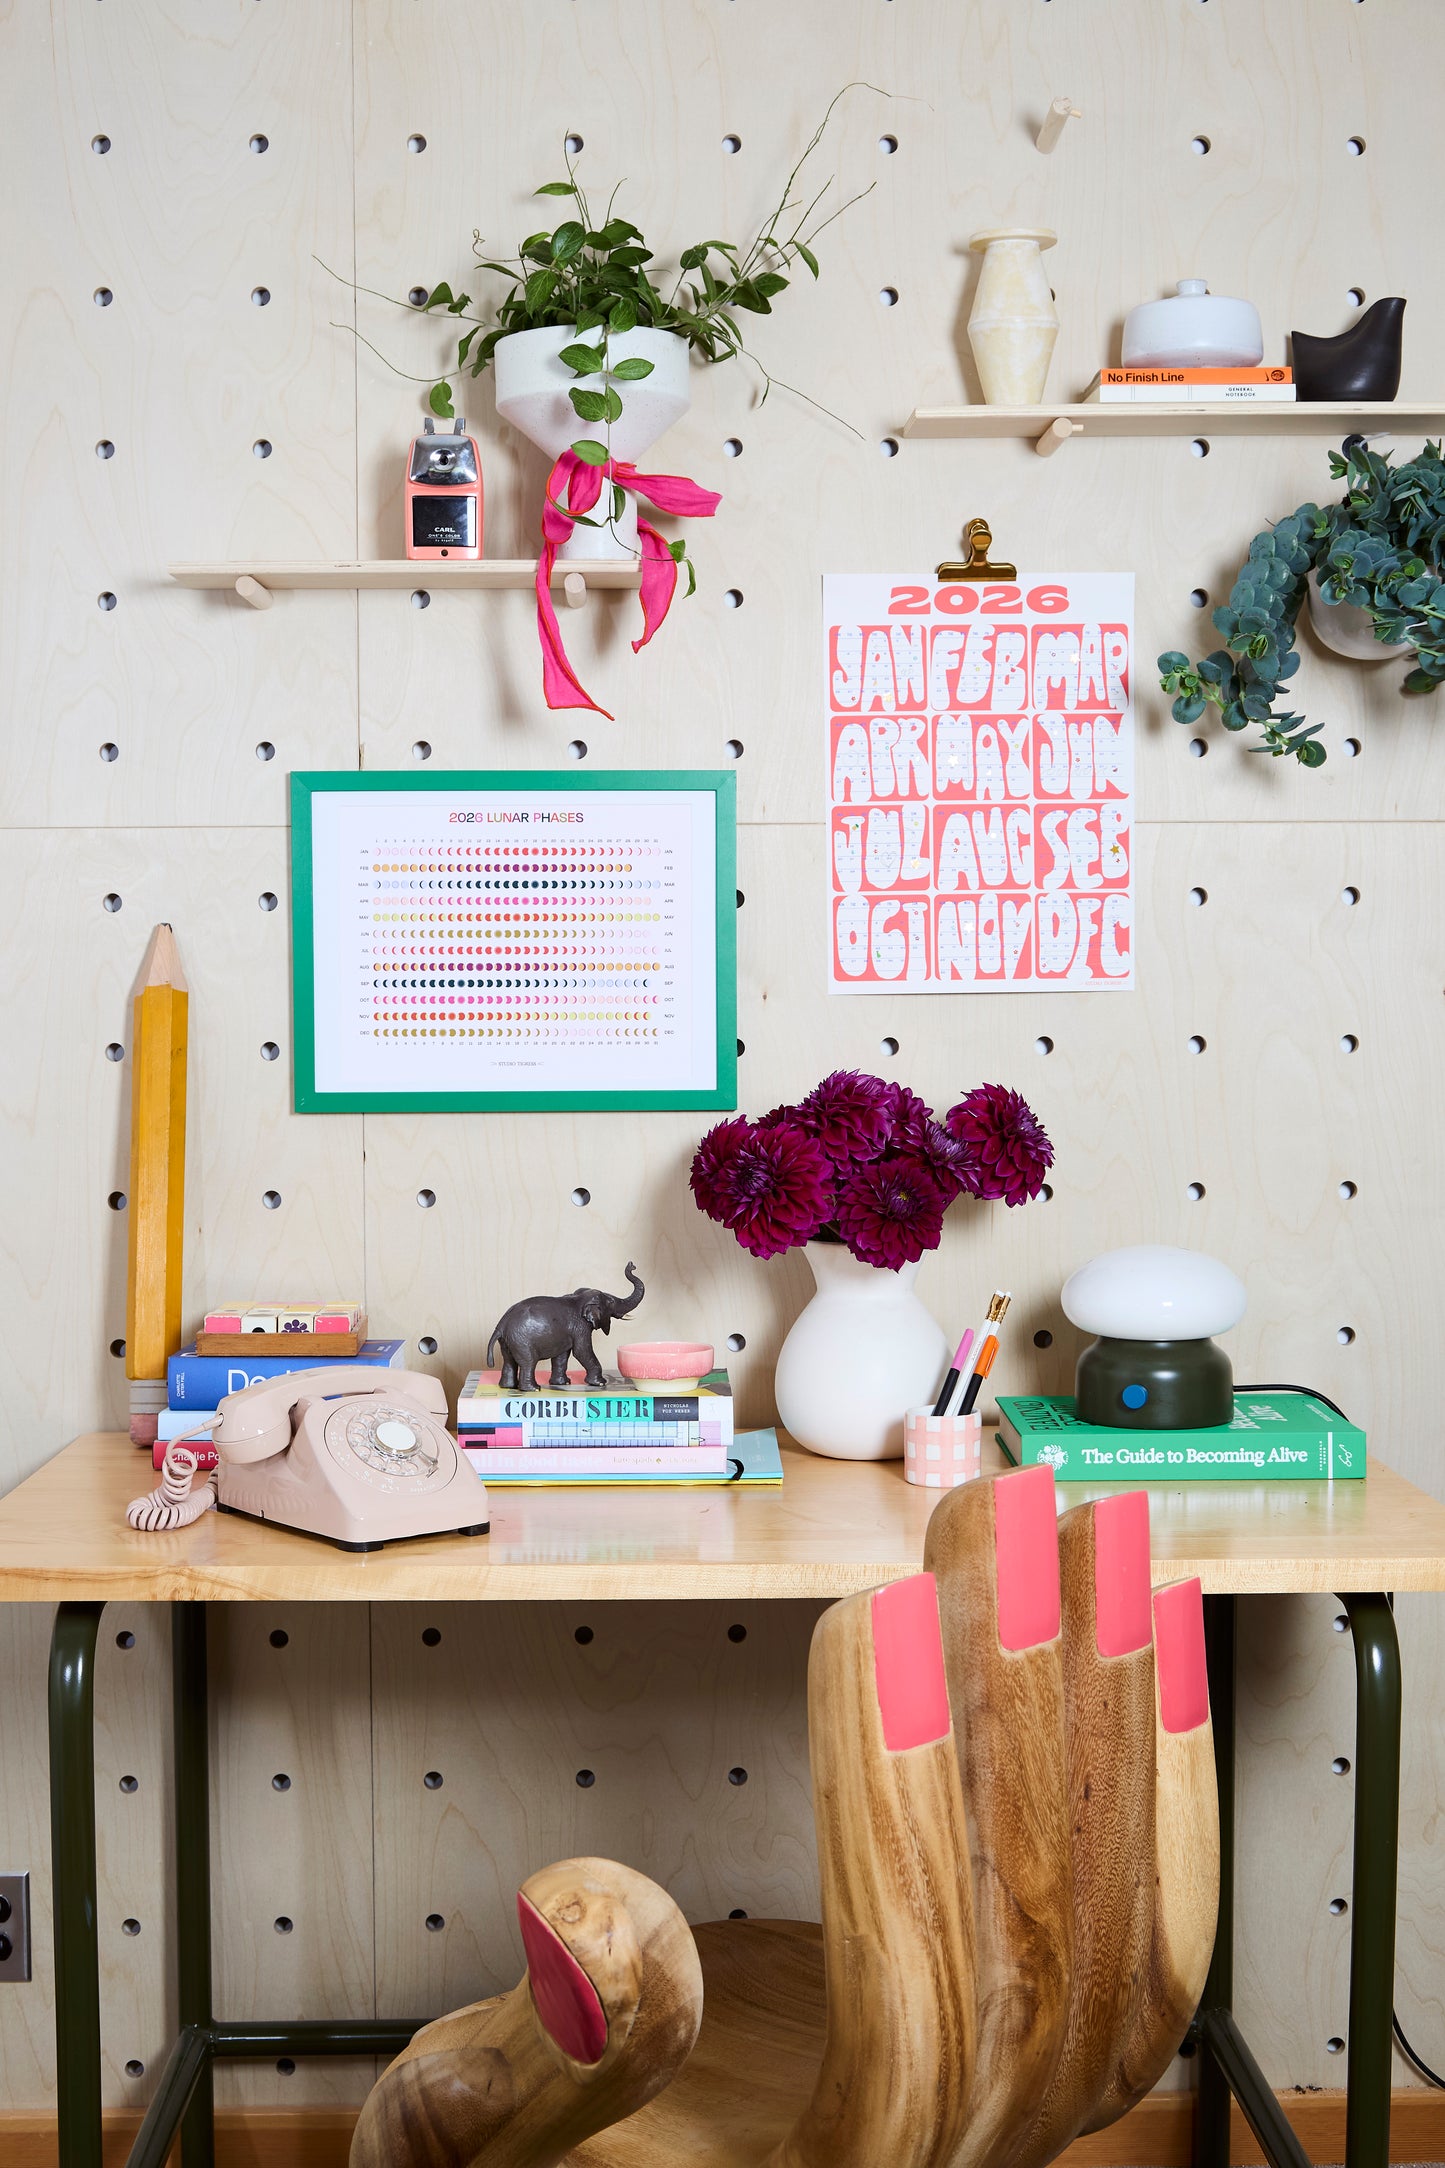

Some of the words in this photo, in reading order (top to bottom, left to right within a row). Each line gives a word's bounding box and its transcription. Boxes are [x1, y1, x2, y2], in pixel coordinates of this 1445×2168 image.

[1108, 373, 1123, 382] No
[1126, 372, 1159, 382] Finish
[1161, 372, 1184, 382] Line
[887, 585, 1070, 615] 2026
[832, 624, 925, 711] JAN
[931, 624, 1026, 711] FEB
[1035, 624, 1128, 710] MAR
[832, 718, 930, 802] APR
[937, 715, 1030, 801] MAY
[1043, 714, 1129, 799] JUN
[449, 812, 484, 824] 2026
[487, 812, 530, 824] LUNAR
[533, 812, 584, 824] PHASES
[835, 804, 930, 893] JUL
[940, 807, 1031, 891] AUG
[1041, 803, 1129, 889] SEP
[835, 893, 927, 980] OCT
[938, 892, 1032, 980] NOV
[1037, 893, 1130, 979] DEC
[505, 1399, 650, 1420] CORBUSIER
[1082, 1449, 1113, 1464] The
[1116, 1448, 1164, 1464] Guide
[1167, 1450, 1184, 1464] to
[1186, 1448, 1265, 1468] Becoming
[1267, 1447, 1308, 1464] Alive
